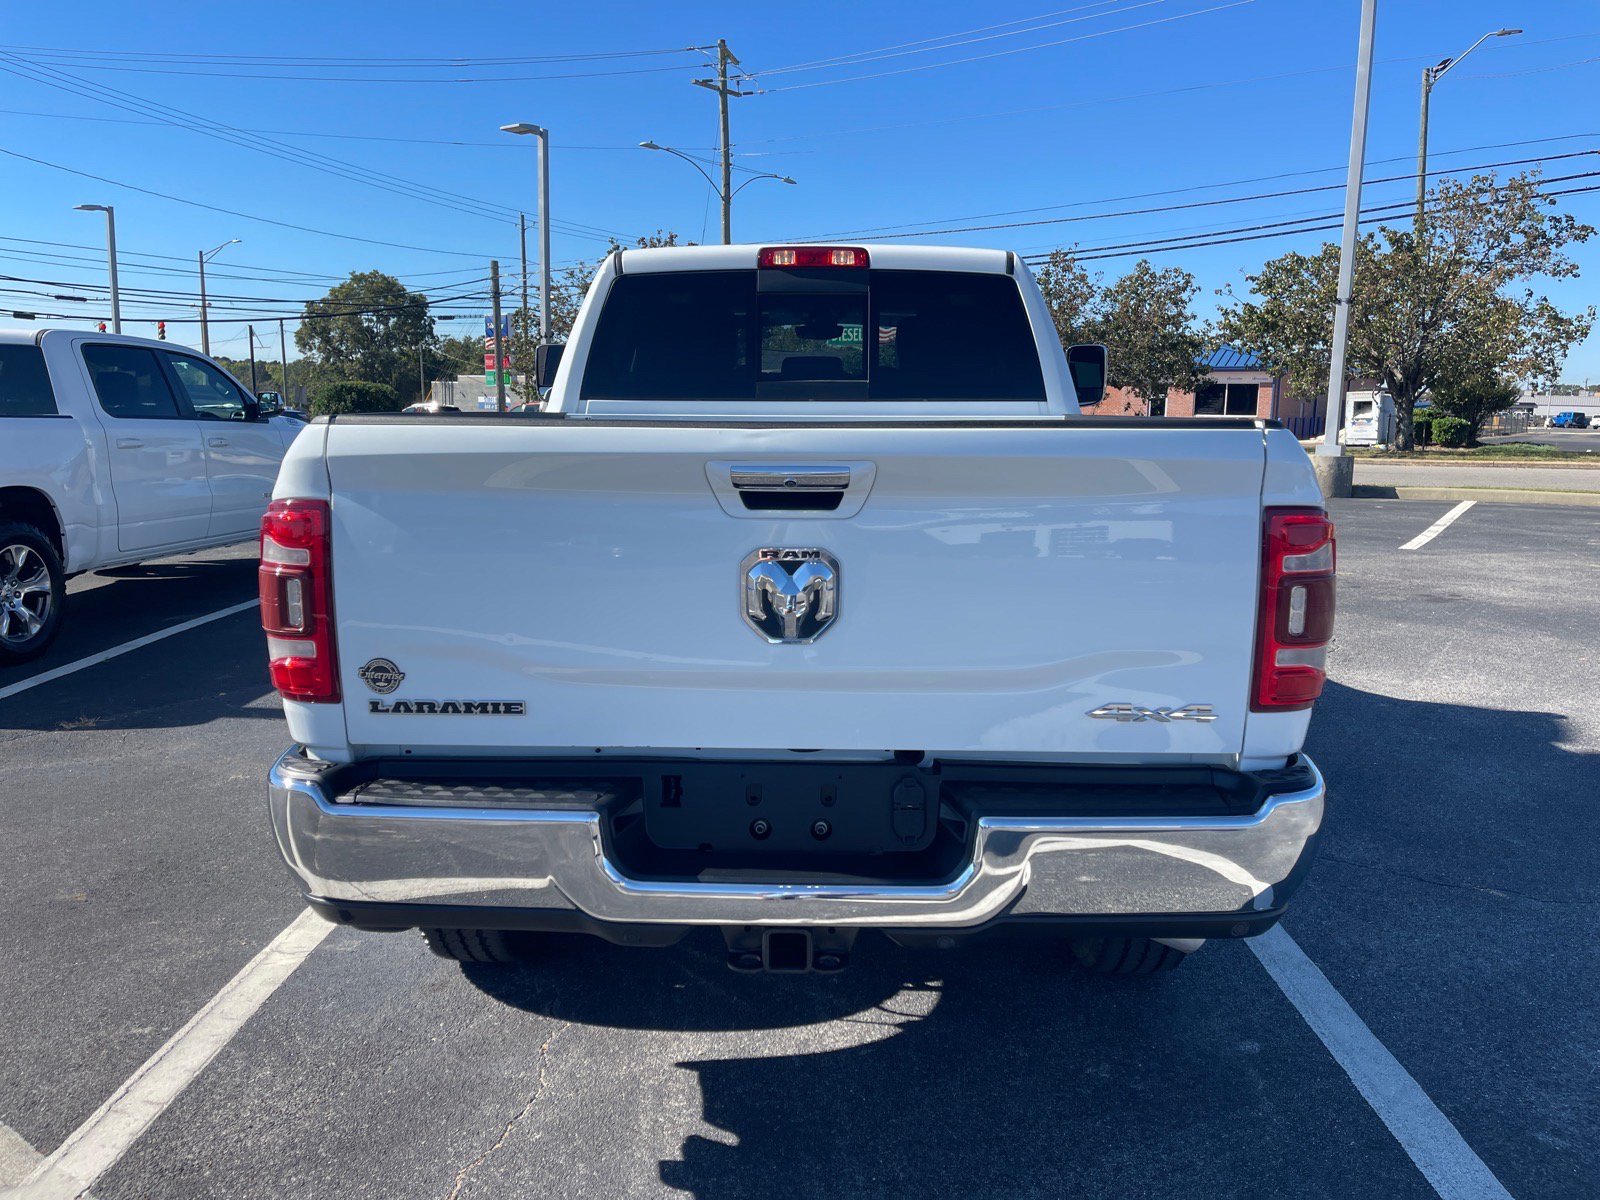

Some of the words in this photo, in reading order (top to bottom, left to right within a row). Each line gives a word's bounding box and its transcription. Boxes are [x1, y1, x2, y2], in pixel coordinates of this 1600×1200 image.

[831, 328, 863, 342] ESEL
[760, 550, 820, 559] RAM
[358, 667, 405, 683] Enterprise
[369, 700, 525, 715] LARAMIE
